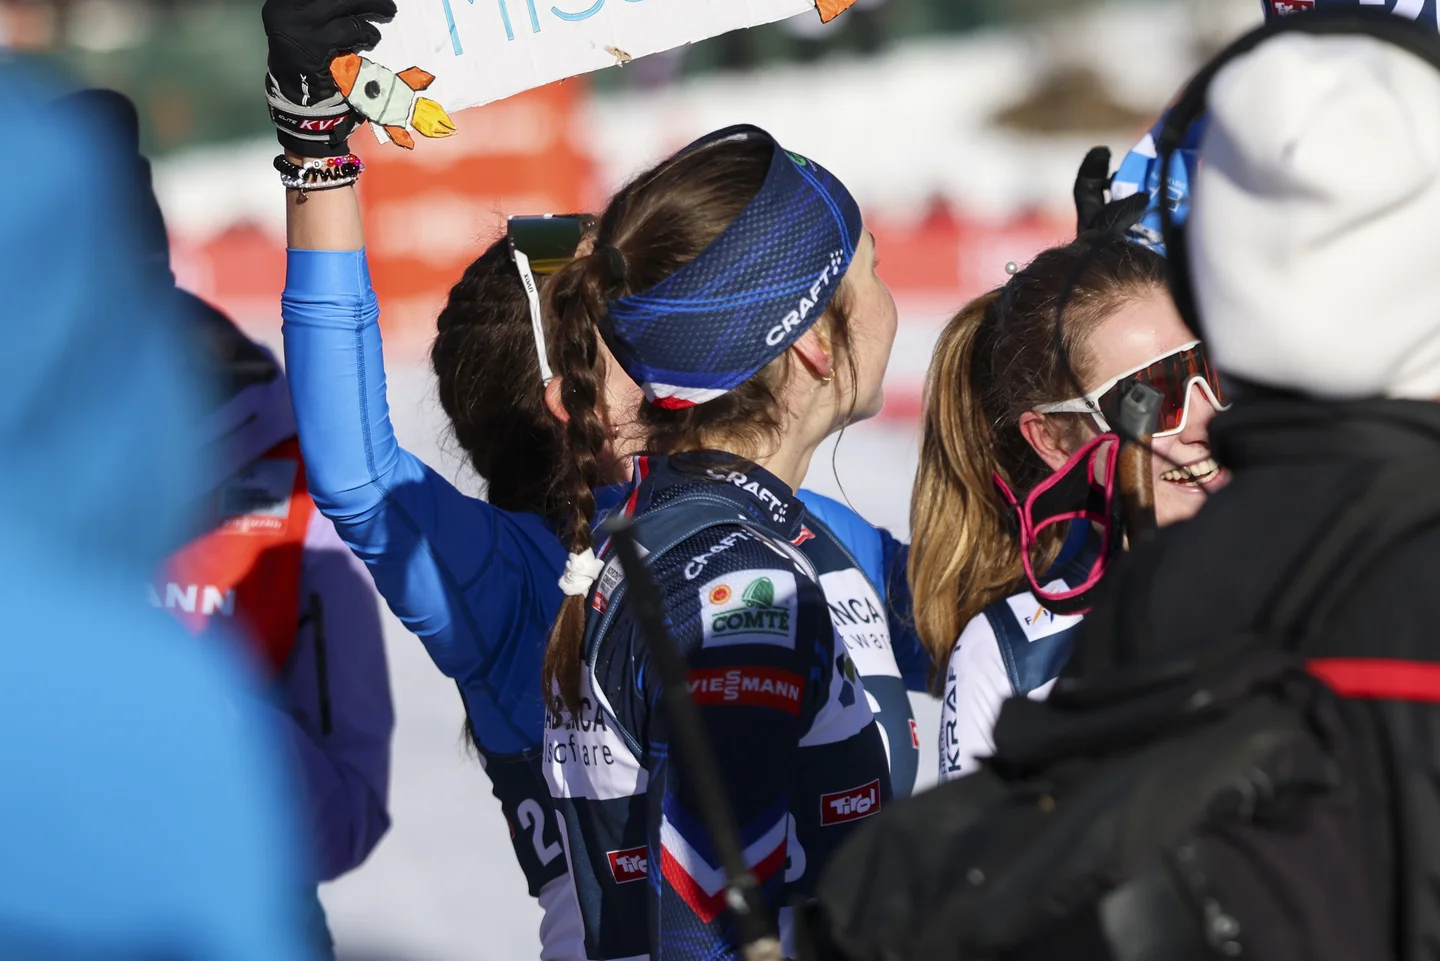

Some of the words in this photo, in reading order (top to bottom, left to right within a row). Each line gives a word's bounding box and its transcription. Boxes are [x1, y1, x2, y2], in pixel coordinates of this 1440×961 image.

[765, 263, 831, 347] CRAFT
[685, 670, 800, 701] VIESSMANN
[830, 788, 876, 816] Tirol
